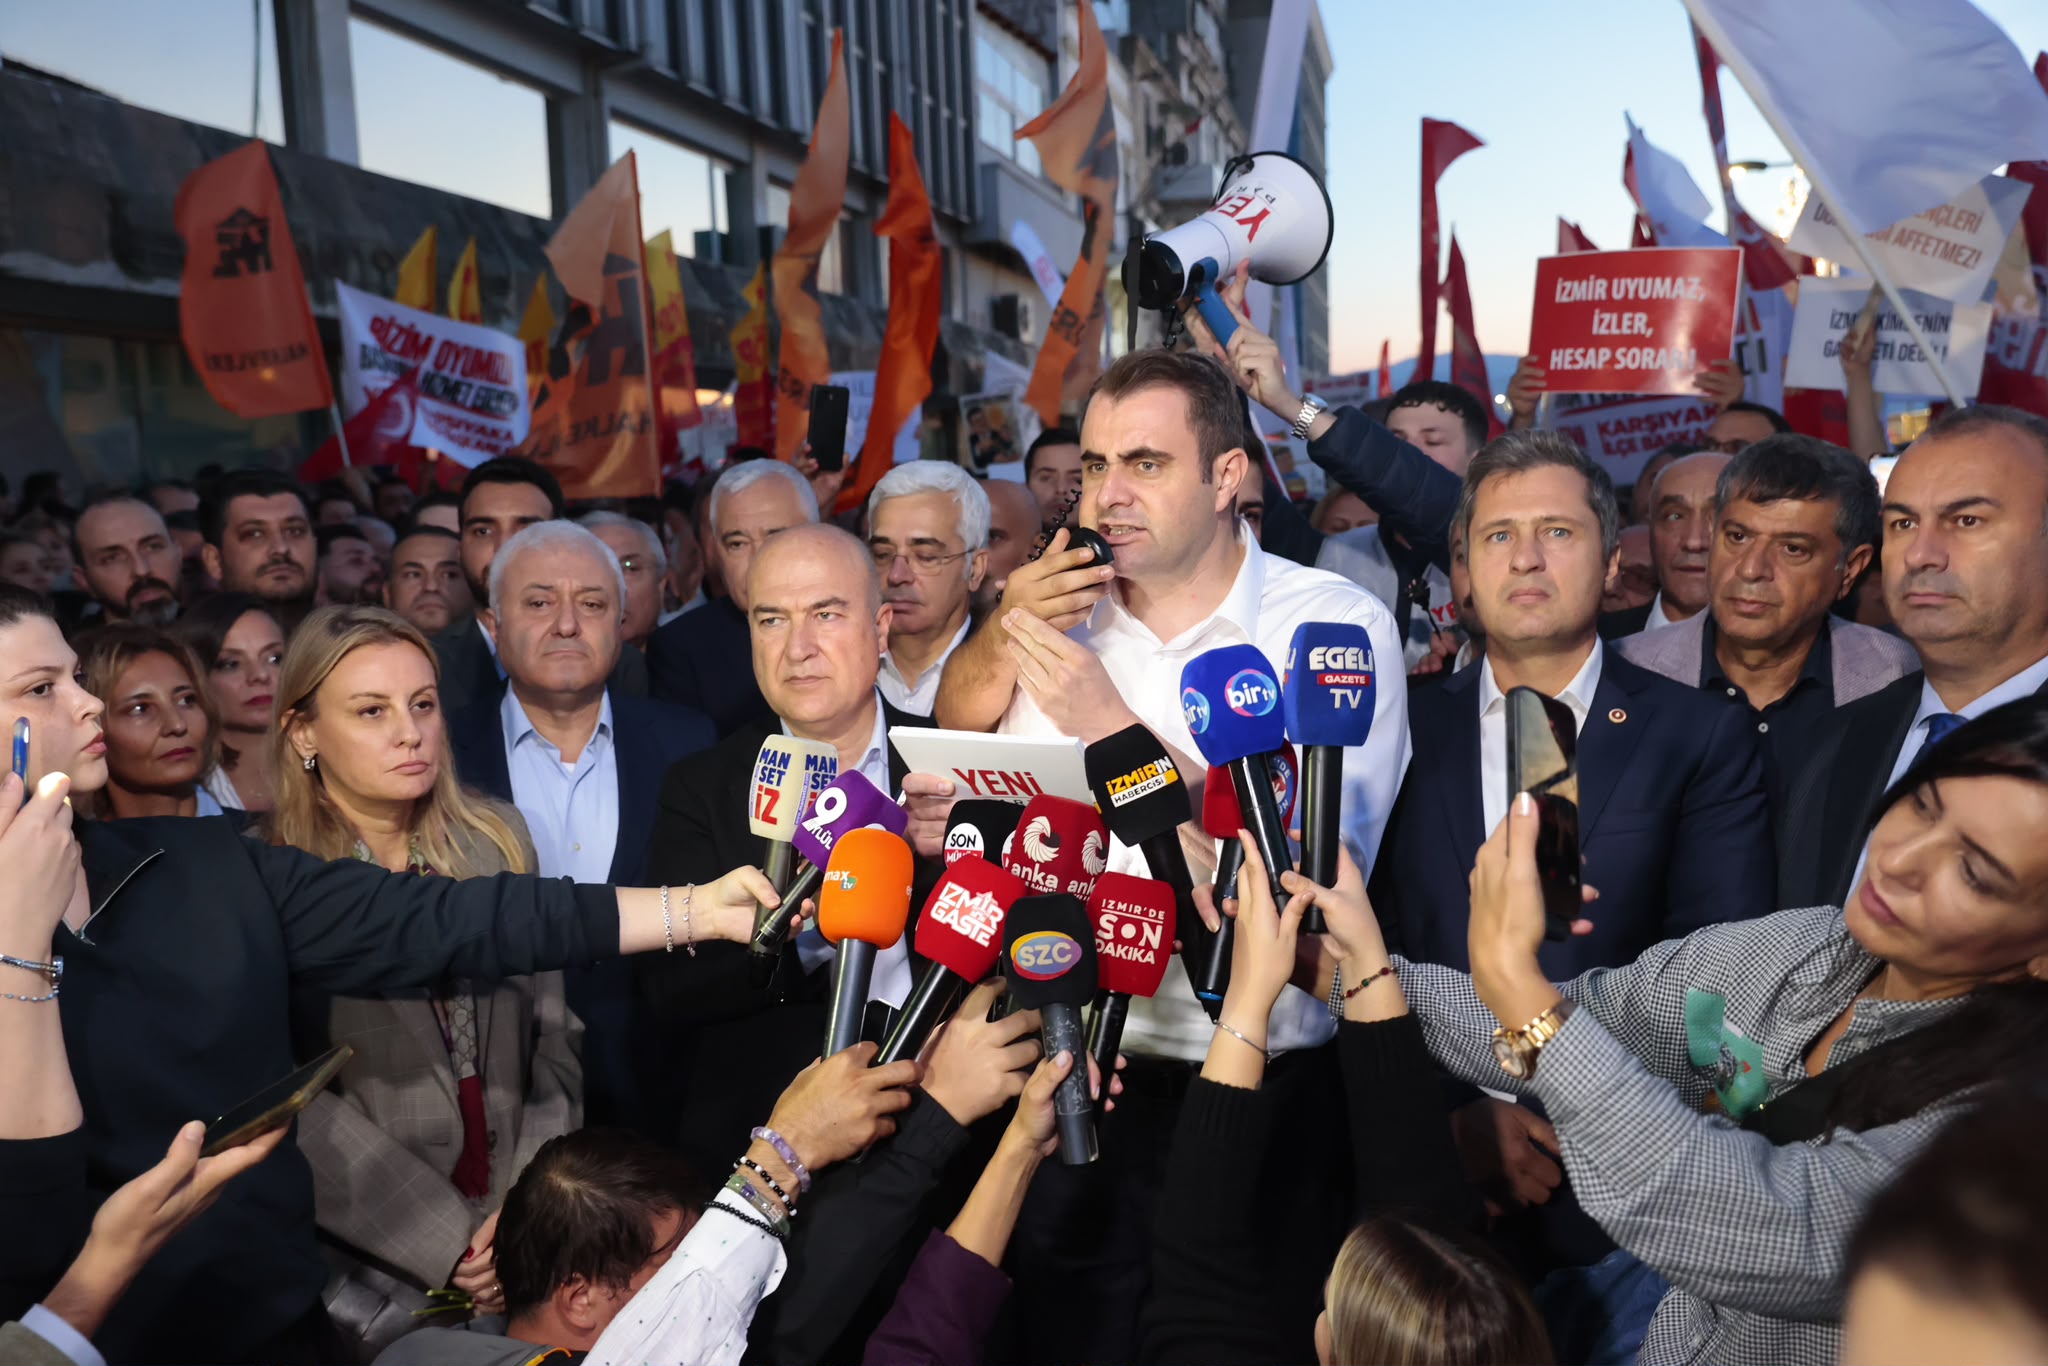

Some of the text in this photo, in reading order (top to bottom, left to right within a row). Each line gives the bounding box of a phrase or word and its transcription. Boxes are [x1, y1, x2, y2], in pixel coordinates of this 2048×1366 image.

[1555, 275, 1706, 303] İZMİR UYUMAZ,
[1592, 309, 1654, 338] İZLER,
[1550, 347, 1612, 370] HESAP
[1598, 404, 1718, 436] KARŞIYAK
[1325, 674, 1366, 684] GAZETE
[1330, 688, 1362, 709] TV
[759, 748, 792, 769] MAN
[805, 754, 837, 774] MAN
[759, 766, 786, 787] SET
[950, 833, 977, 848] SON
[843, 881, 853, 889] tv
[1011, 863, 1059, 889] anka
[930, 900, 997, 948] GASTE
[1019, 942, 1072, 967] SZC
